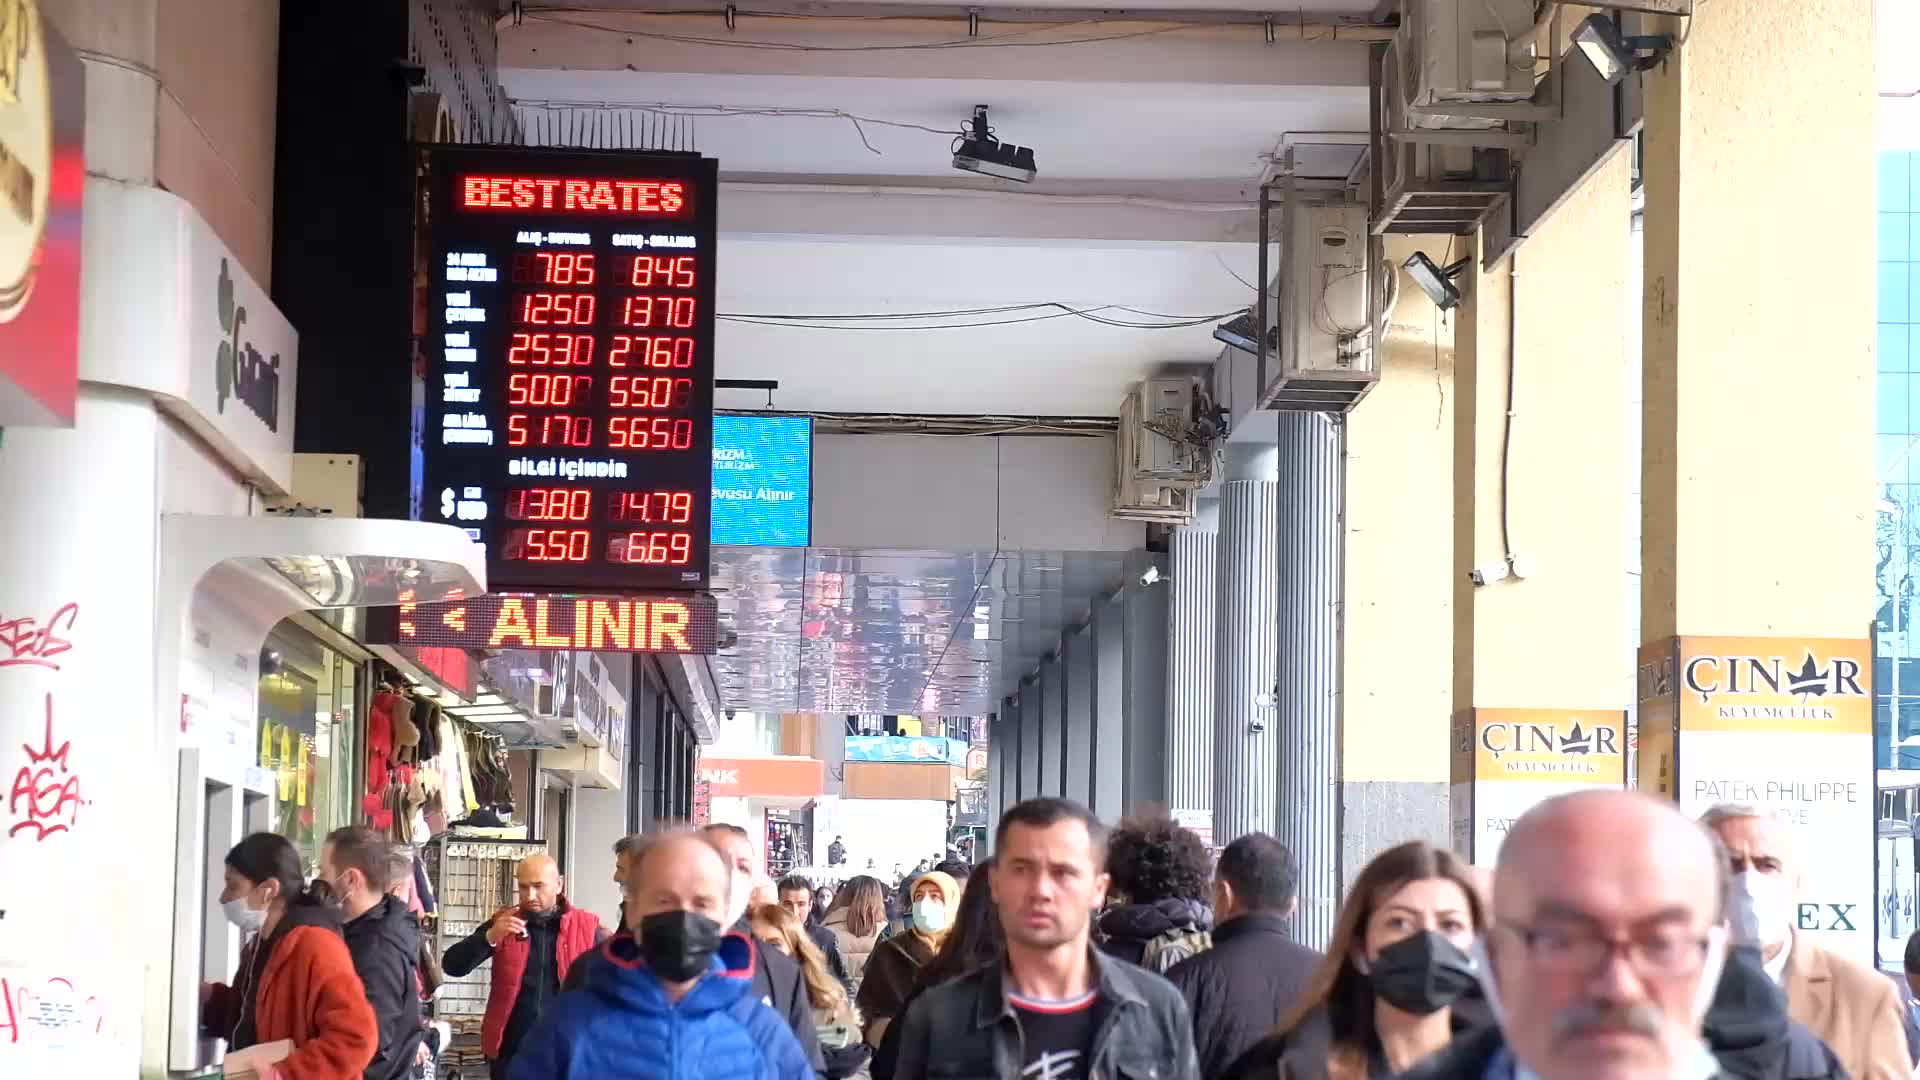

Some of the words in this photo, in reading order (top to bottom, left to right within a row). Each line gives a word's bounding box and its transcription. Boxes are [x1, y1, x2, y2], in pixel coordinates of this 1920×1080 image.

[464, 177, 560, 208] BEST
[565, 180, 683, 212] RATES
[536, 253, 595, 285] 785
[632, 256, 695, 288] 845
[523, 294, 595, 325] 1250
[623, 296, 696, 328] 1370
[508, 333, 594, 365] 2530
[608, 336, 694, 368] 2760
[508, 415, 592, 447] 5170
[608, 417, 693, 449] 5650
[509, 457, 556, 477] BİLGİ
[559, 458, 627, 480] İÇİNDİR
[489, 599, 692, 650] ALINIR
[1719, 707, 1833, 719] KUYUMCULUK
[1695, 780, 1759, 801] PATEK
[1766, 781, 1857, 803] PHILIPPE
[1797, 903, 1857, 931] EX
